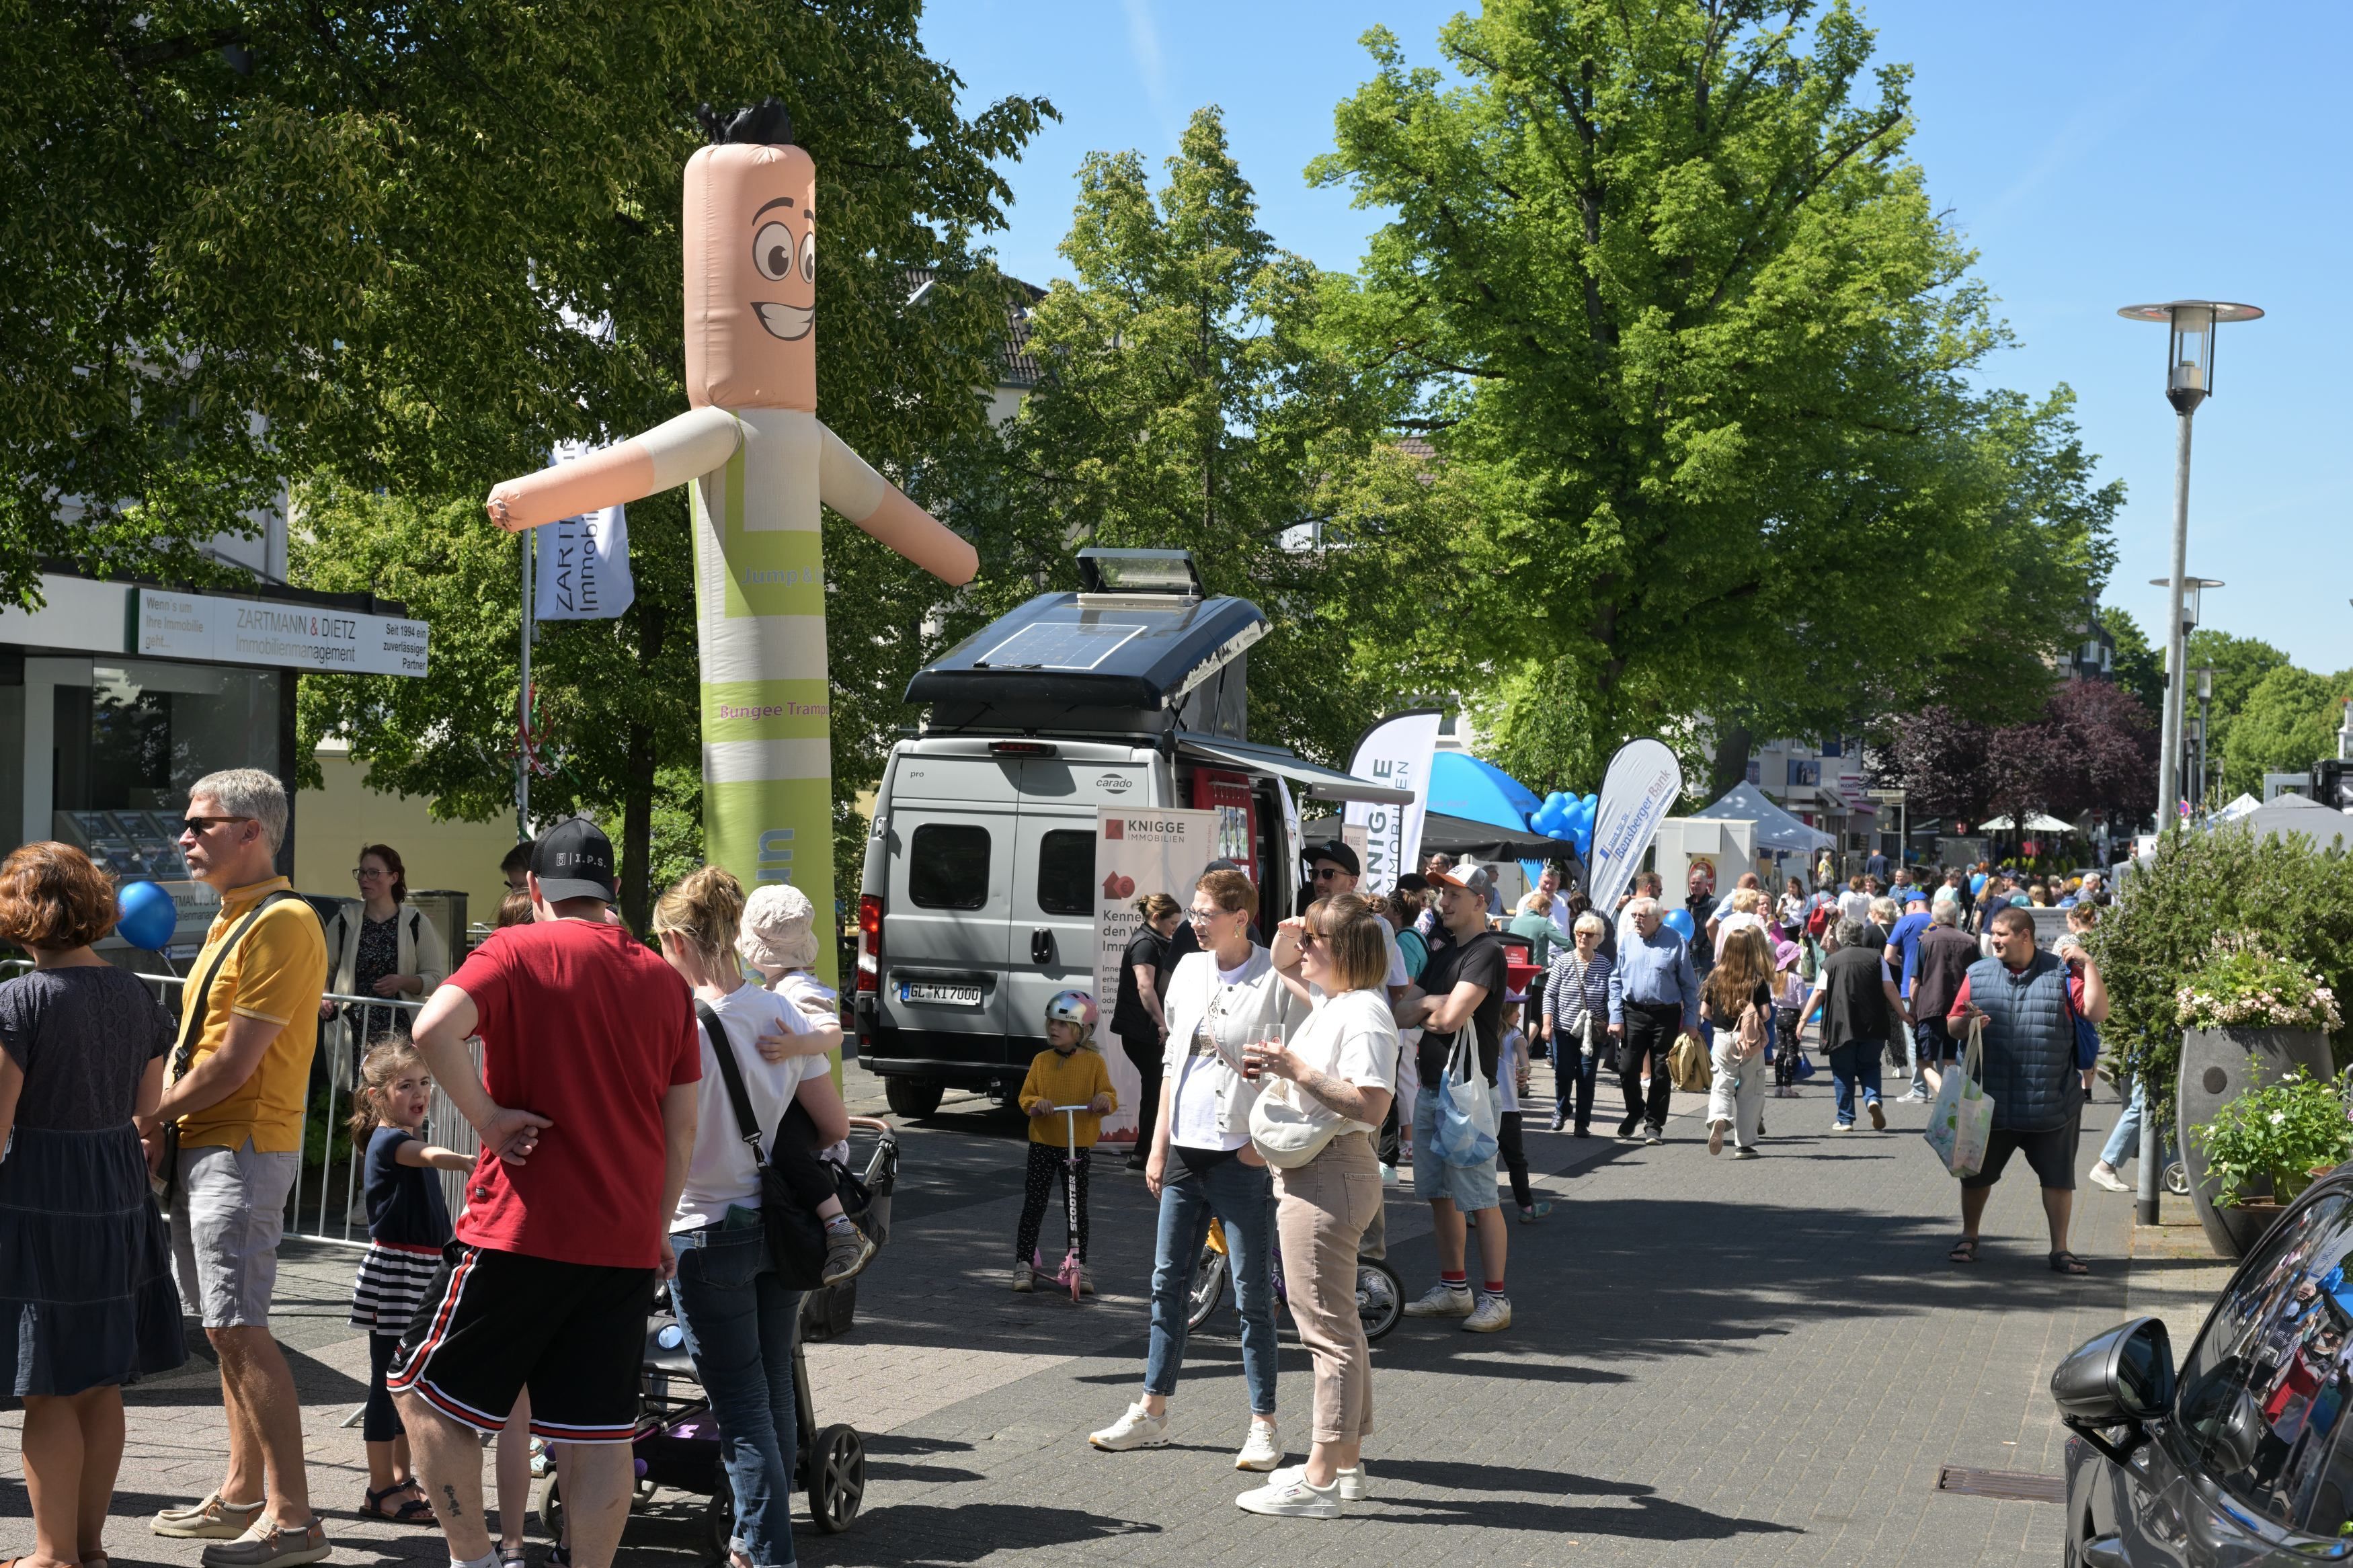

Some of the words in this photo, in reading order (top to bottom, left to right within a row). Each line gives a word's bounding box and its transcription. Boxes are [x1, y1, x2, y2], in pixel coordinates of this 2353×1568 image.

[742, 567, 798, 587] Jump
[803, 566, 813, 583] &
[180, 603, 192, 613] um
[147, 615, 161, 628] Ihre
[164, 617, 204, 632] Immobilie
[237, 608, 307, 635] ZARTMANN
[310, 617, 318, 636] &
[322, 618, 356, 639] DIETZ
[386, 624, 399, 635] Seit
[401, 626, 415, 637] 1994
[417, 628, 426, 638] ein
[237, 634, 355, 664] Immobilienmanagement
[383, 642, 426, 657] zuverlässiger
[403, 658, 426, 670] Partner
[720, 705, 783, 720] Bungee
[1096, 778, 1133, 788] carado
[1615, 796, 1654, 860] Bensberger
[1648, 770, 1671, 798] Bank
[1129, 820, 1185, 833] KNIGGE
[1128, 834, 1185, 843] IMMOBILIEN
[1103, 925, 1125, 936] den
[911, 985, 924, 997] GL
[934, 986, 947, 999] KI
[951, 987, 979, 1001] 7000
